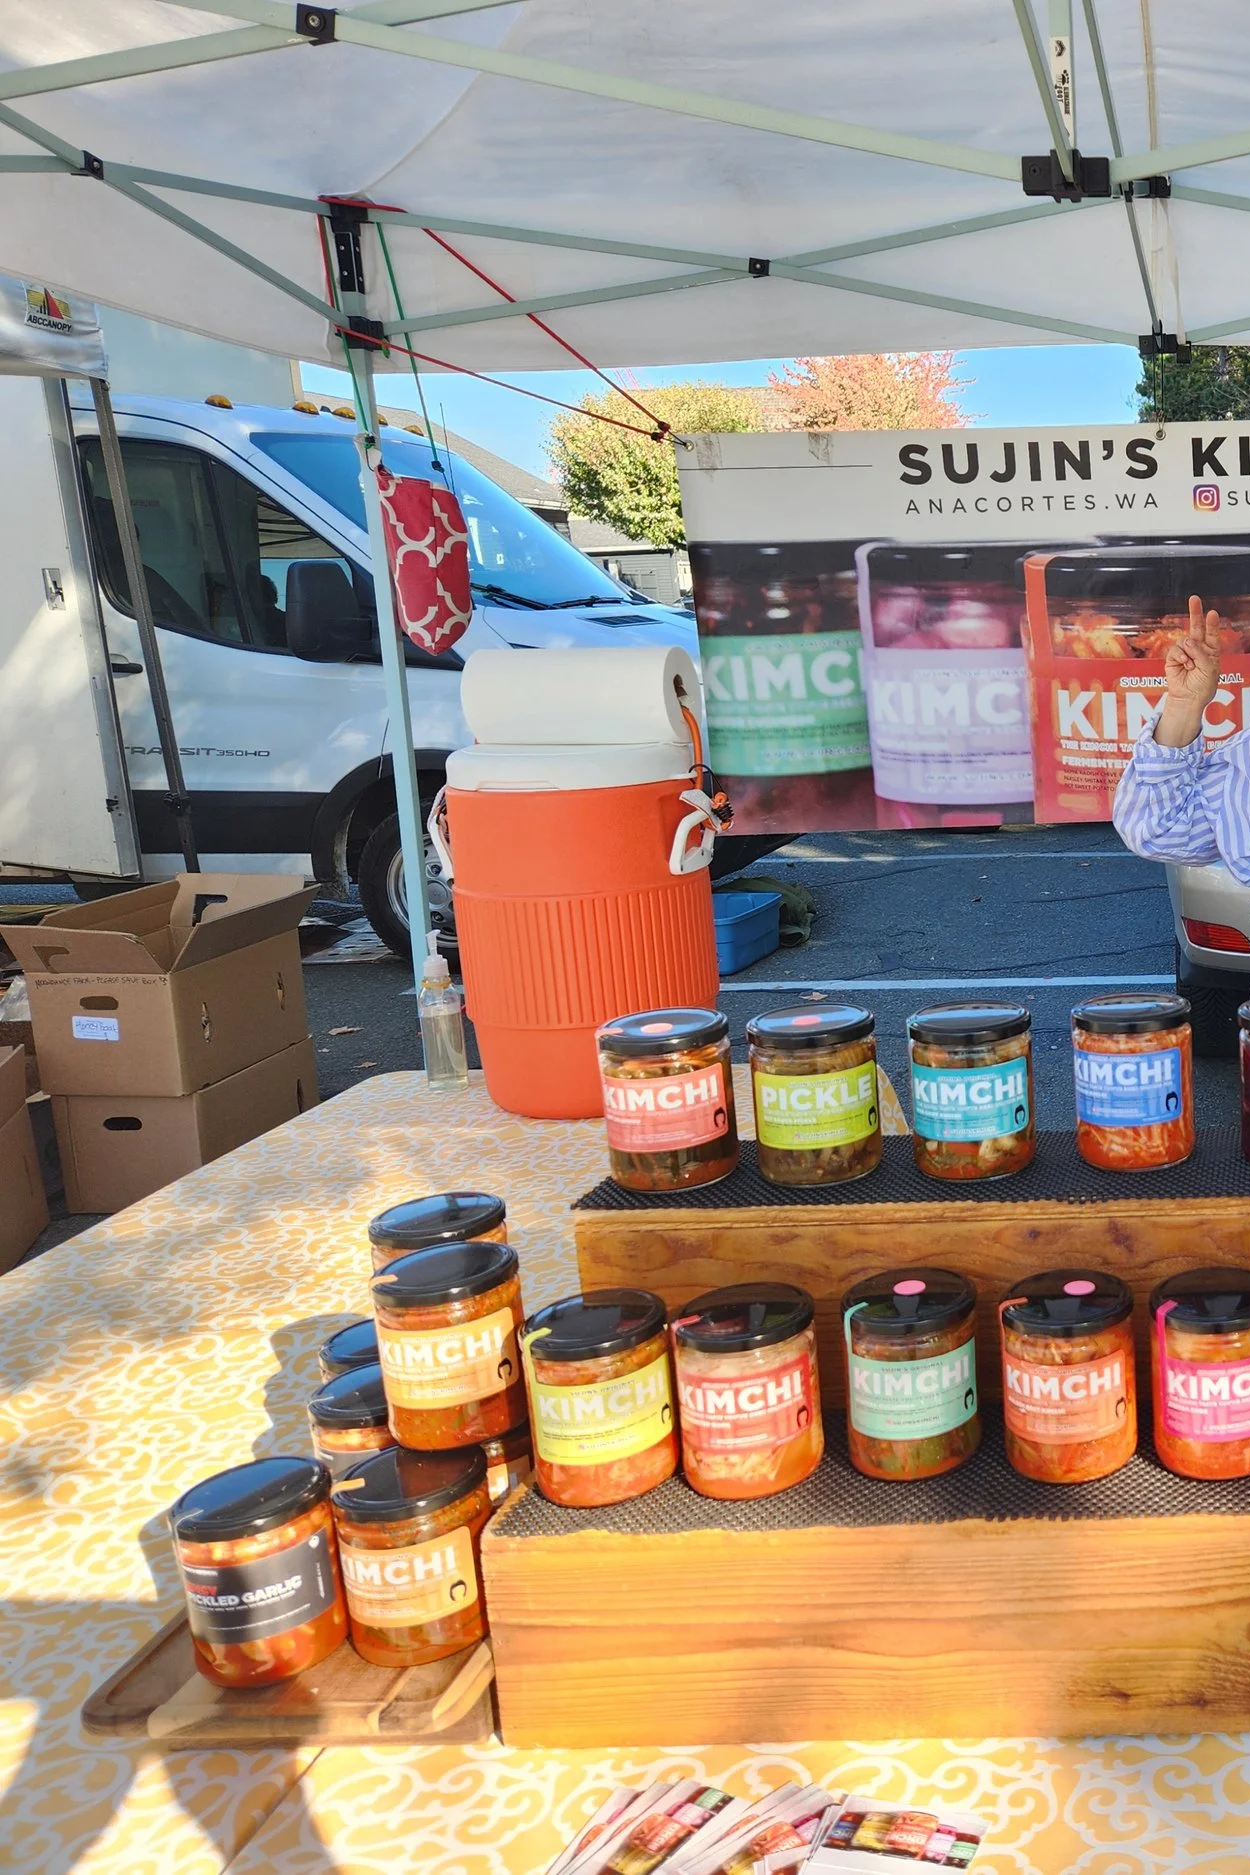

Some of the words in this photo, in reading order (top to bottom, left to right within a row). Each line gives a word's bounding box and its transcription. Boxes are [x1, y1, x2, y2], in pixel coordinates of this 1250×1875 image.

[27, 314, 72, 333] ABCCANOPY
[898, 437, 1158, 485] SUJIN'S
[905, 493, 1159, 515] ANACORTES.WA
[124, 746, 216, 756] RASIT
[914, 1072, 1024, 1105] KIMCHI
[1074, 1055, 1172, 1086] KIMCHI
[604, 1074, 719, 1112] KIMCHI
[761, 1074, 873, 1111] PICKLE
[382, 1325, 502, 1368] KIMCHI
[681, 1370, 802, 1414] KIMCHI
[853, 1354, 970, 1397] KIMCHI
[1006, 1361, 1121, 1401] KIMCHI
[538, 1368, 665, 1421] KIMCHI
[241, 1574, 302, 1603] GARLIC
